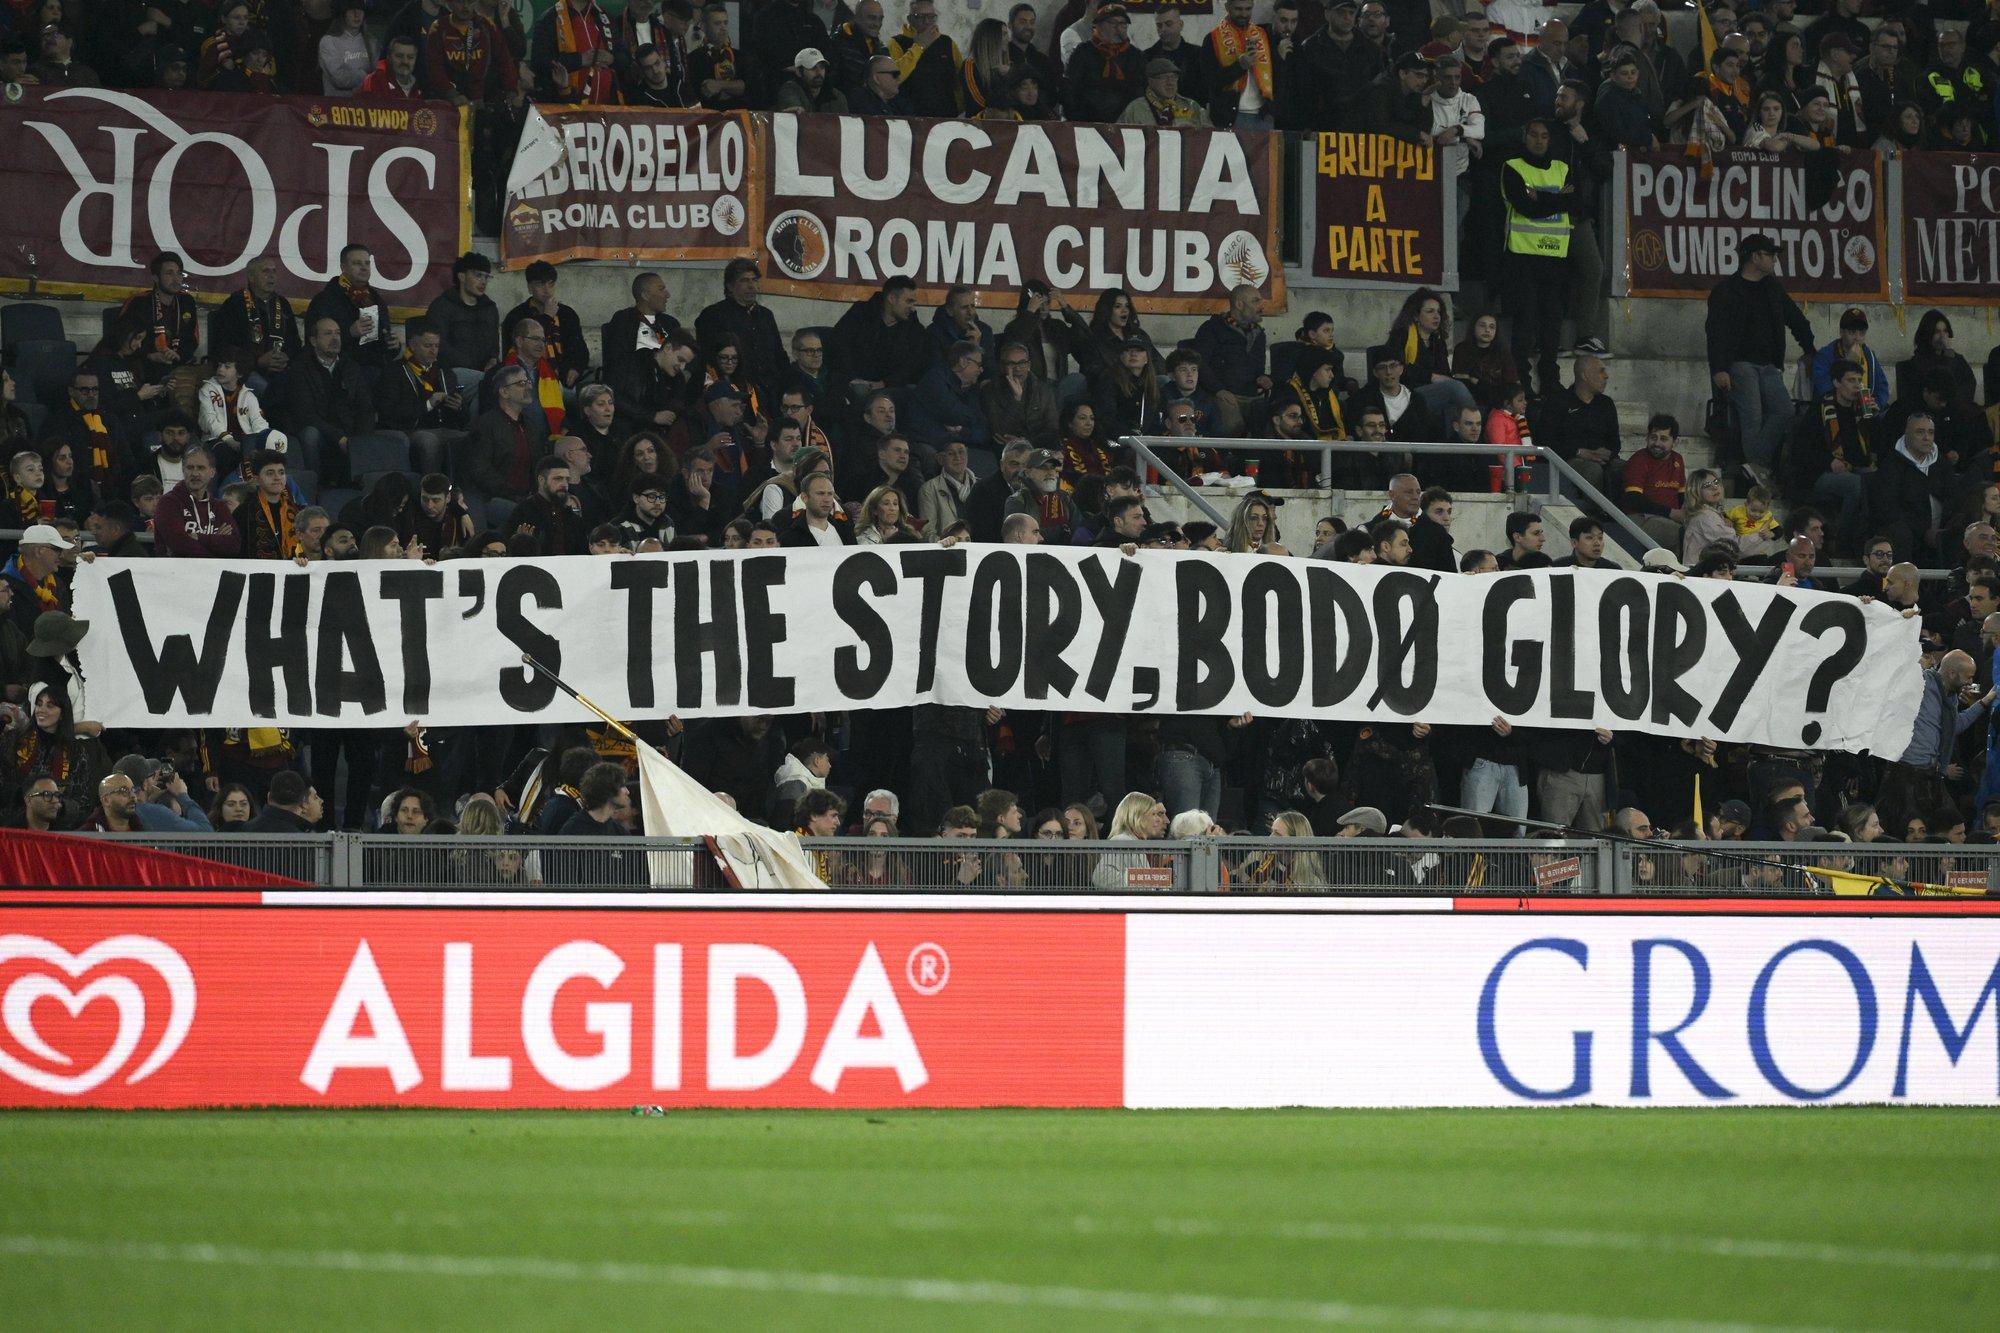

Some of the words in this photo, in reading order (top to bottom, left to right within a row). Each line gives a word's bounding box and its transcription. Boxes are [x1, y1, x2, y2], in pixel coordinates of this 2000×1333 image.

[331, 106, 367, 127] CLUB
[368, 108, 409, 130] ROMA
[23, 86, 436, 291] SPQR
[772, 112, 1262, 216] LUCANIA
[1731, 152, 1757, 162] ROMA
[541, 203, 621, 235] ROMA
[626, 203, 711, 230] CLUB
[1366, 184, 1387, 222] A
[833, 215, 1023, 288] ROMA
[1043, 223, 1215, 293] CLUB
[1328, 225, 1424, 275] PARTE
[107, 560, 563, 719] WHAT'S
[610, 555, 797, 709] THE
[832, 548, 1160, 712] STORY,
[1175, 559, 1442, 716] BODØ
[1482, 574, 1868, 747] GLORY?
[299, 937, 930, 1095] ALGIDA
[1476, 936, 2000, 1102] GROM
